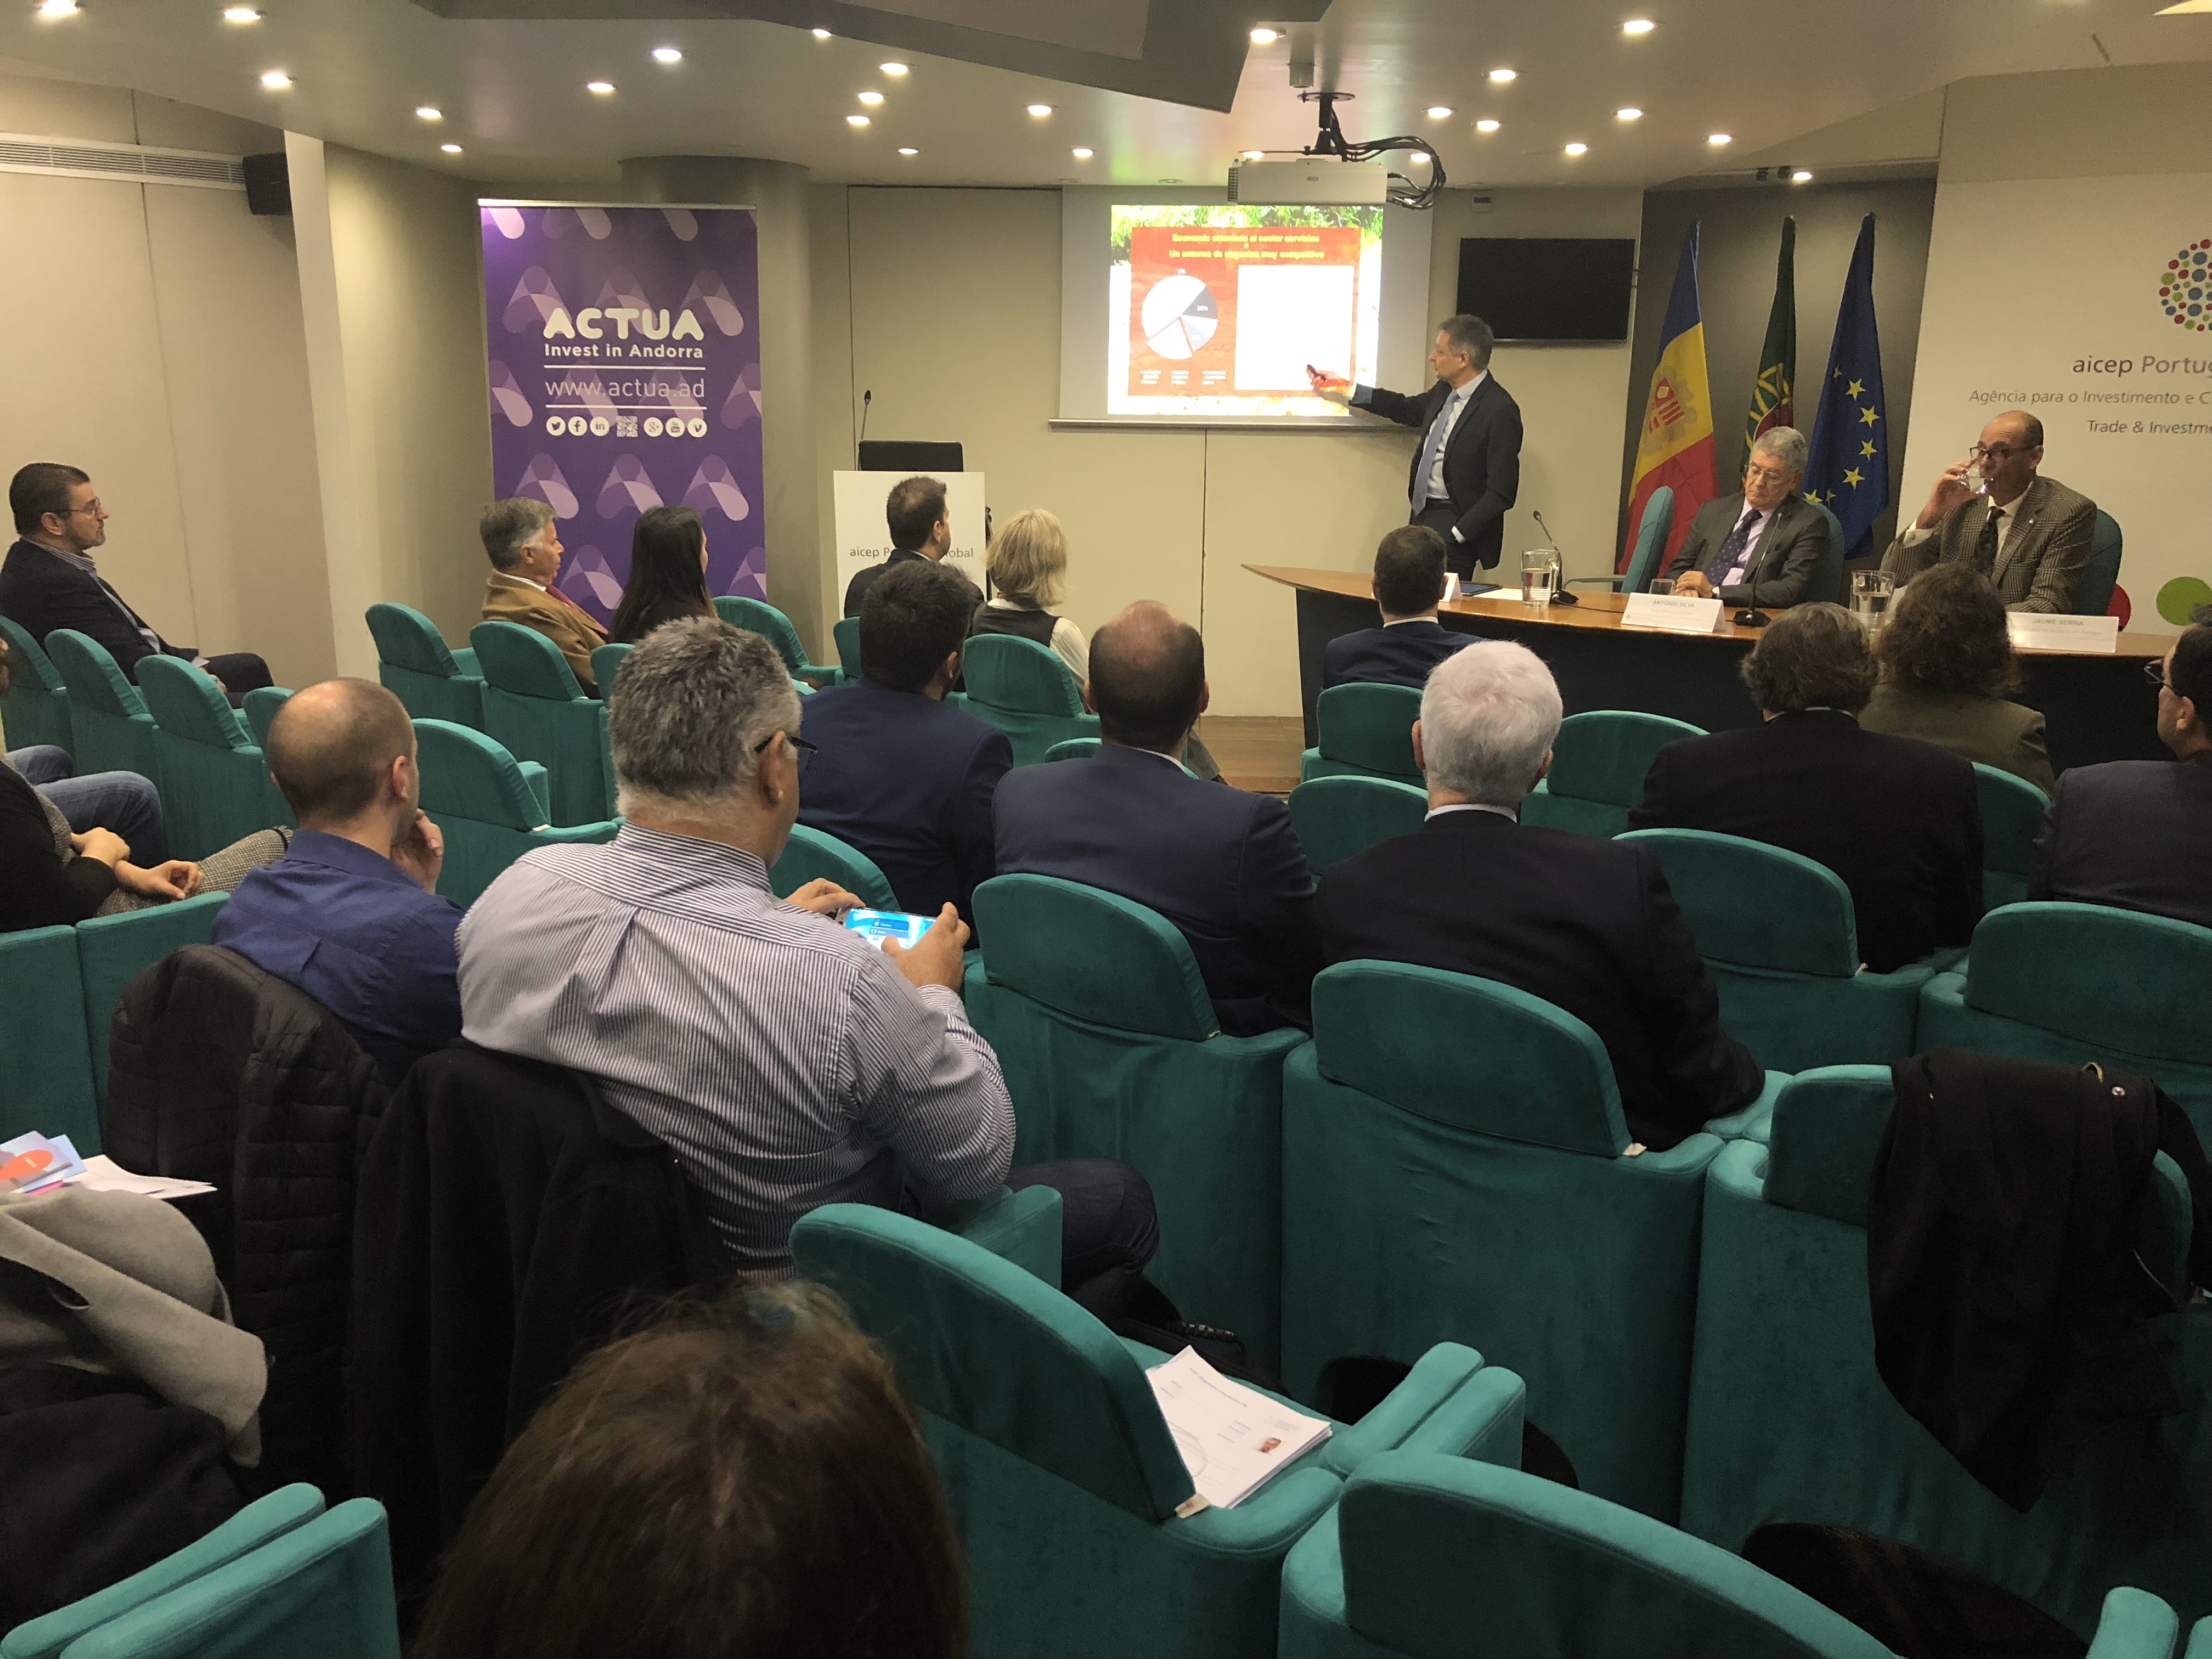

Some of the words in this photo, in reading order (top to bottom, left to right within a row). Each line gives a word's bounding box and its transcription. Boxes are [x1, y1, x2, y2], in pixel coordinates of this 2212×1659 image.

[1284, 234, 1319, 242] servicios
[1224, 250, 1260, 259] negocios
[1279, 251, 1325, 259] competitivo
[543, 308, 704, 341] ACTUA
[545, 343, 599, 357] Invest
[606, 343, 622, 357] in
[629, 344, 703, 358] Andorra
[2073, 355, 2132, 377] aicep
[545, 378, 705, 398] www.actua.ad
[1968, 390, 2027, 405] Agência
[2031, 393, 2063, 405] para
[2069, 393, 2078, 403] o
[2083, 391, 2180, 404] Investimento
[2185, 394, 2194, 404] e
[2087, 420, 2128, 432] Trade
[2132, 421, 2144, 433] &
[850, 546, 879, 558] aicep
[946, 548, 973, 557] obal
